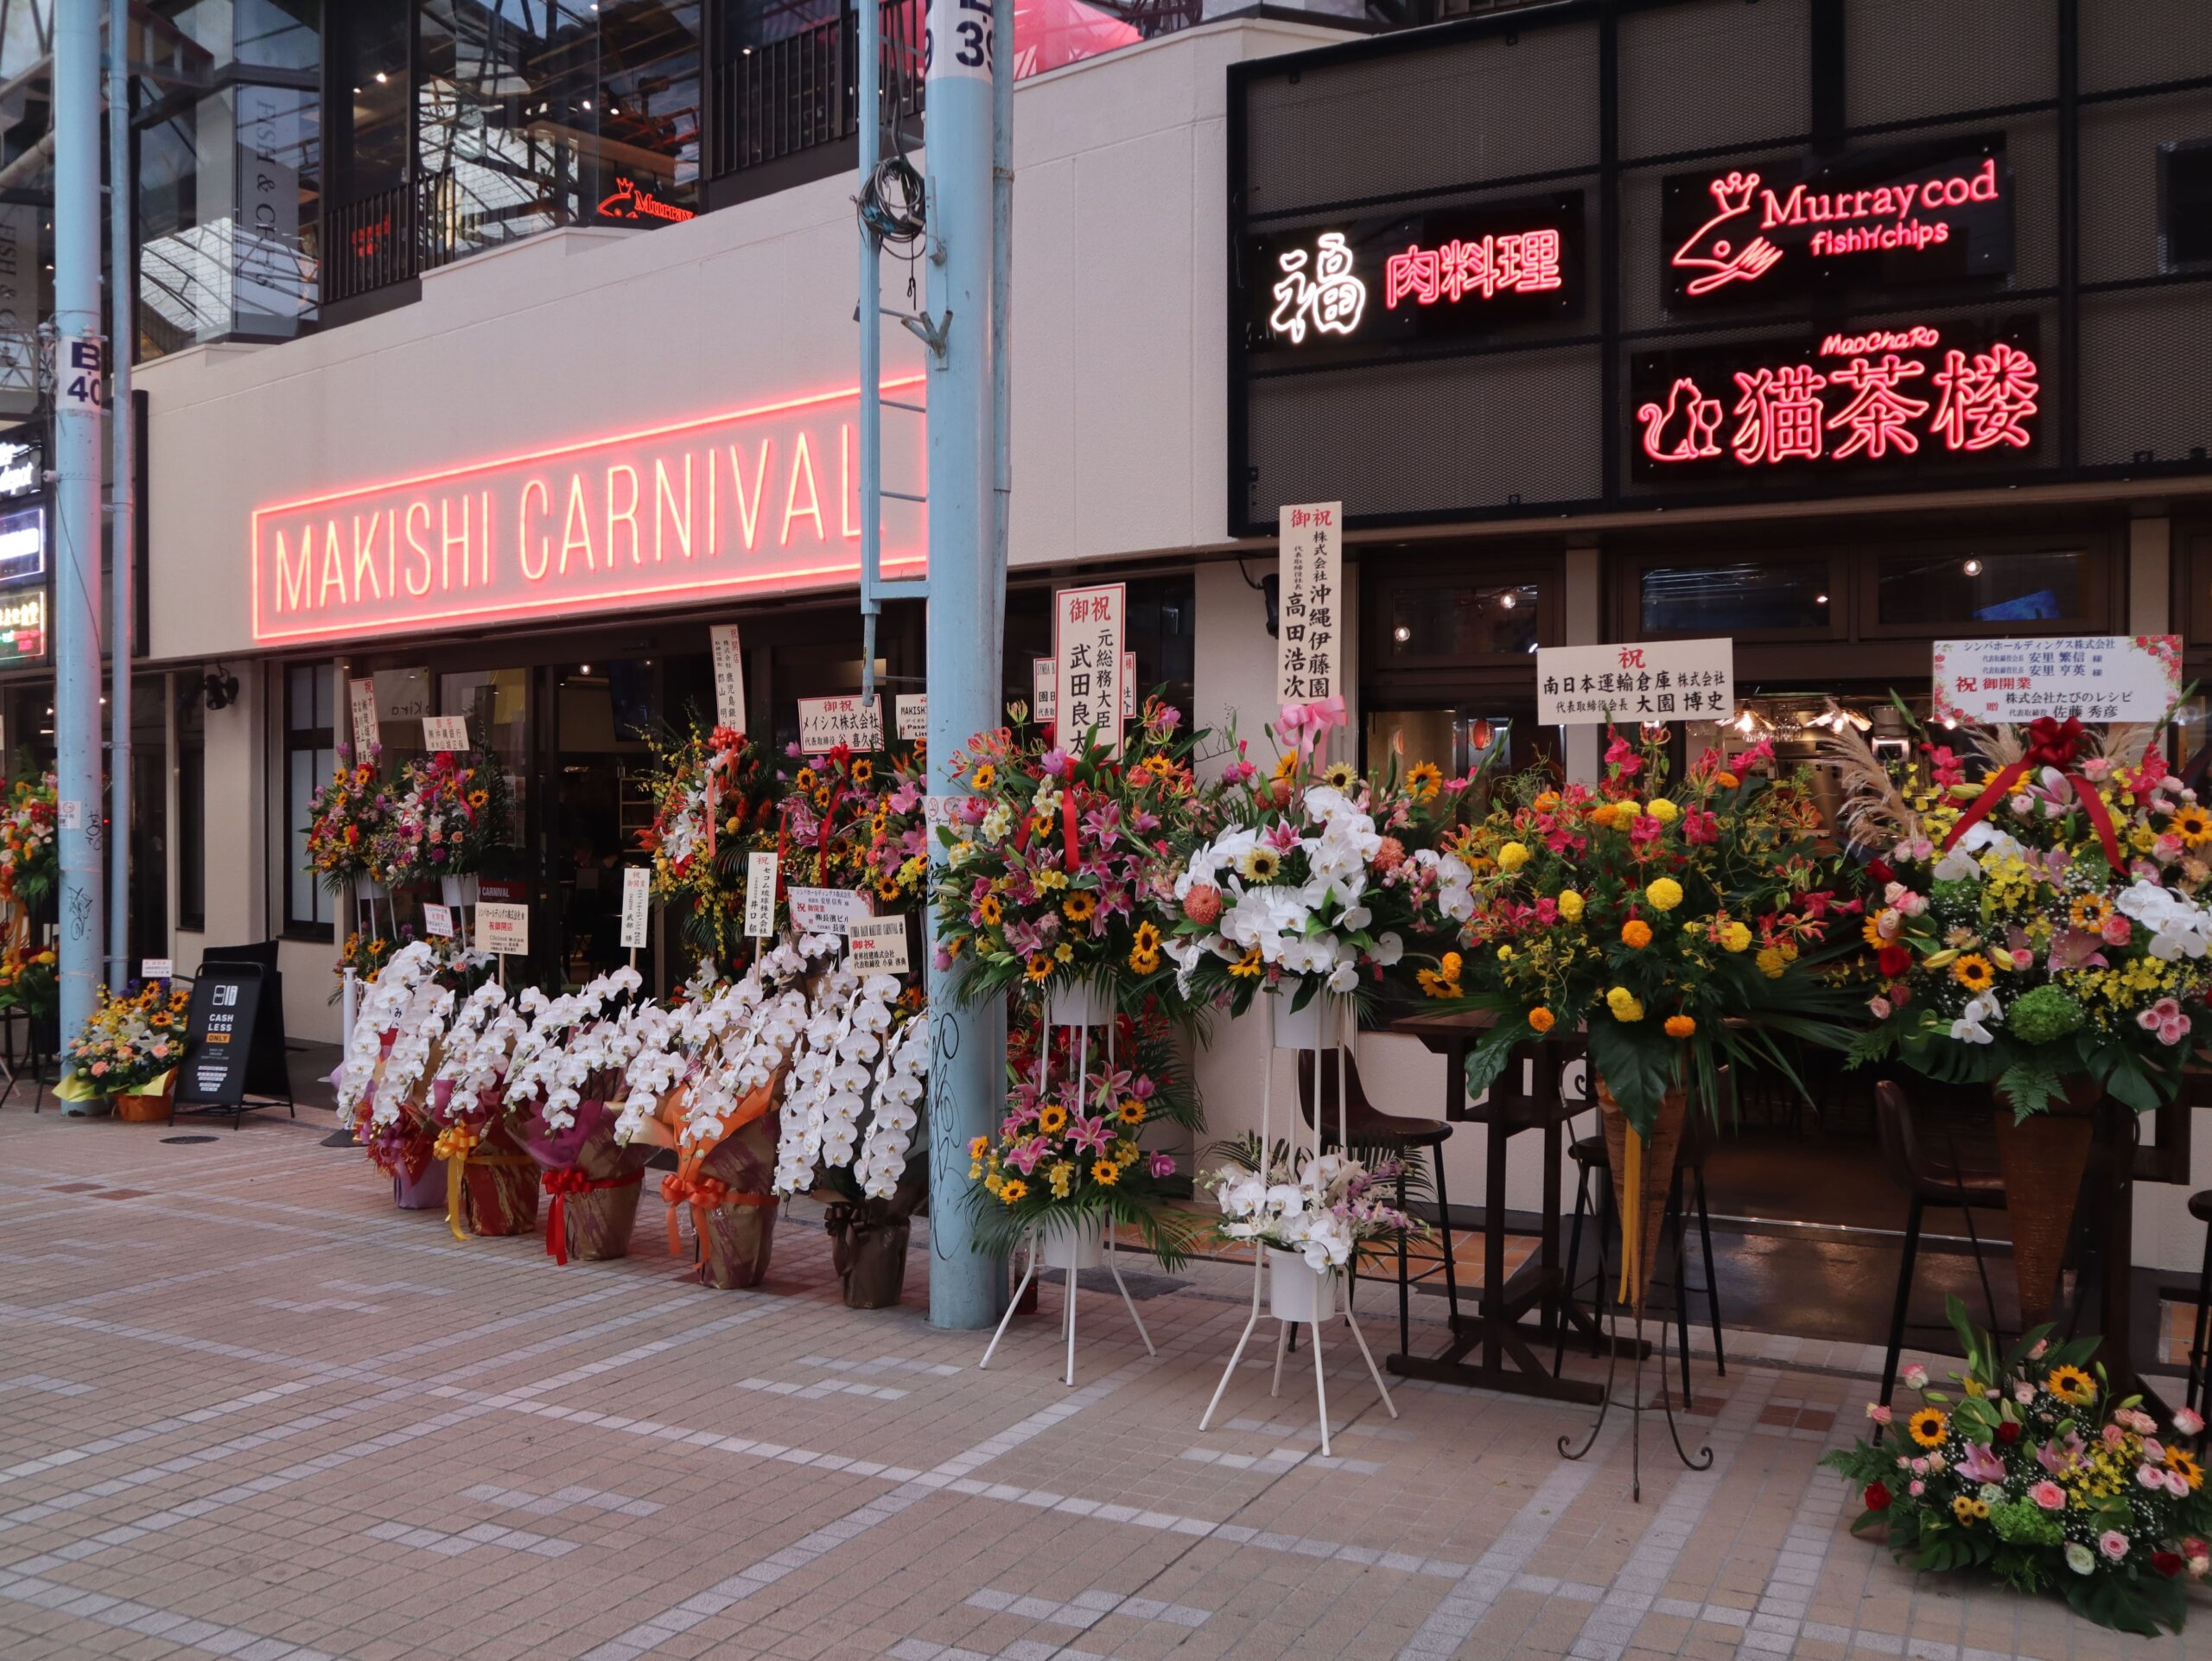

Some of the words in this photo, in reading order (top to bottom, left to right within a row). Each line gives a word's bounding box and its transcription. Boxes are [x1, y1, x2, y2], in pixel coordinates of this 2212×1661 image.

[1759, 183, 1918, 229] Murray
[1921, 159, 1999, 208] cod
[1270, 232, 1367, 344] 福
[1386, 228, 1562, 310] 肉料理
[1732, 343, 2040, 465] 猫茶楼
[275, 490, 490, 613] MAKISHI
[519, 422, 861, 581] CARNIVAL
[1290, 508, 1332, 529] 御祝
[1069, 595, 1111, 624] 御祝
[1618, 646, 1647, 670] 祝
[2028, 652, 2055, 664] 安里
[2059, 651, 2086, 664] 繁信
[1096, 628, 1114, 729] 元総務大臣
[2028, 665, 2055, 677] 安里
[1543, 671, 1673, 696] 南日本運輸倉庫
[1677, 671, 1726, 689] 株式会社
[1955, 676, 1978, 693] 祝
[1983, 677, 2032, 690] 御開業
[823, 699, 855, 713] 御祝
[1070, 643, 1092, 756] 武田良太
[1556, 697, 1629, 714] 代表取締役会長
[1636, 692, 1675, 714] 大園
[1683, 690, 1727, 713] 博史
[900, 705, 926, 716] MAKISH
[2053, 705, 2082, 719] 佐藤
[2088, 705, 2118, 718] 秀彦
[803, 712, 880, 731] メイシス株式会社
[756, 856, 769, 865] 祝
[481, 887, 510, 897] CARNIVAL
[852, 939, 875, 950] 御祝
[209, 1014, 234, 1022] CASH
[207, 1023, 232, 1032] LESS
[208, 1034, 228, 1042] ONLY
